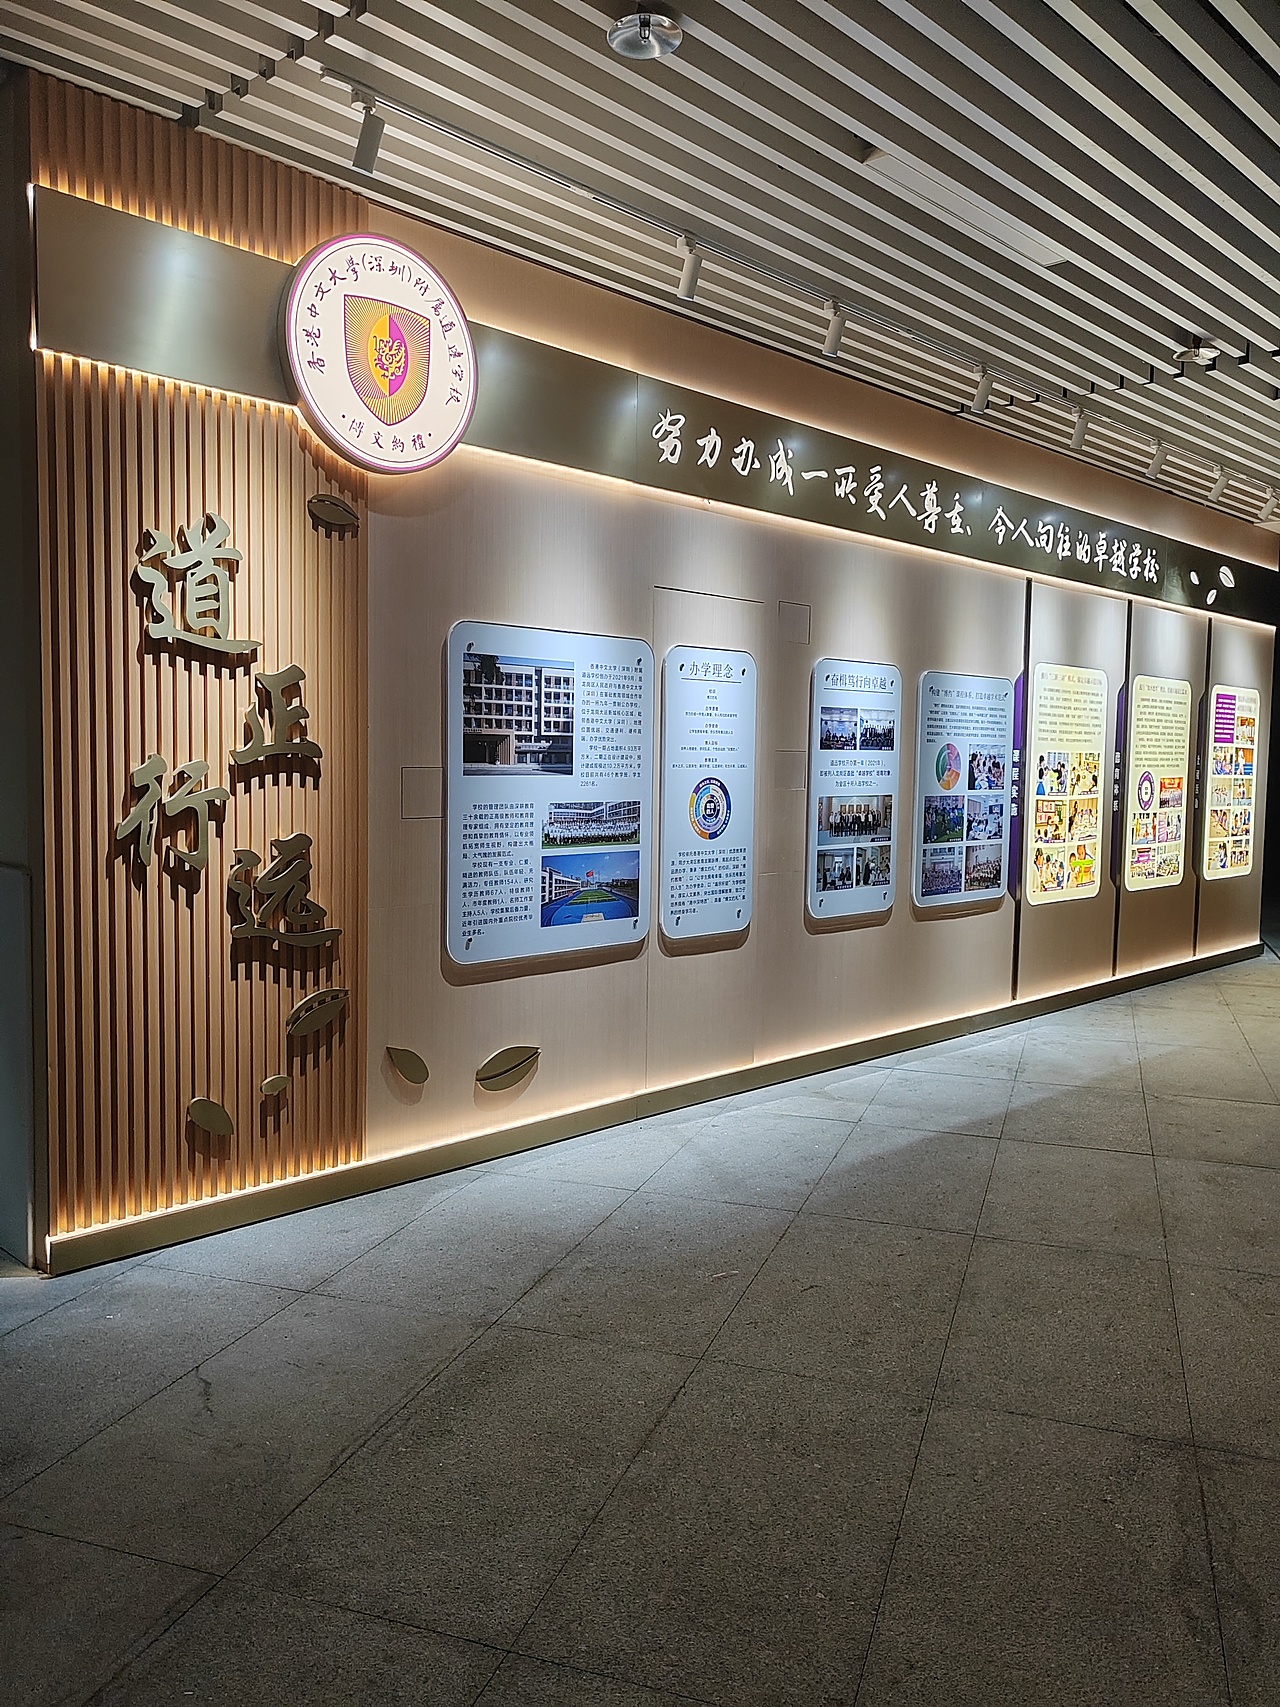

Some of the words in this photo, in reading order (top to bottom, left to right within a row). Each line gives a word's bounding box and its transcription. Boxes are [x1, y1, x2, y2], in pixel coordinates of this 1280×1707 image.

[689, 661, 734, 678] 办学理念
[831, 673, 888, 690] 奋楫笃行向卓越
